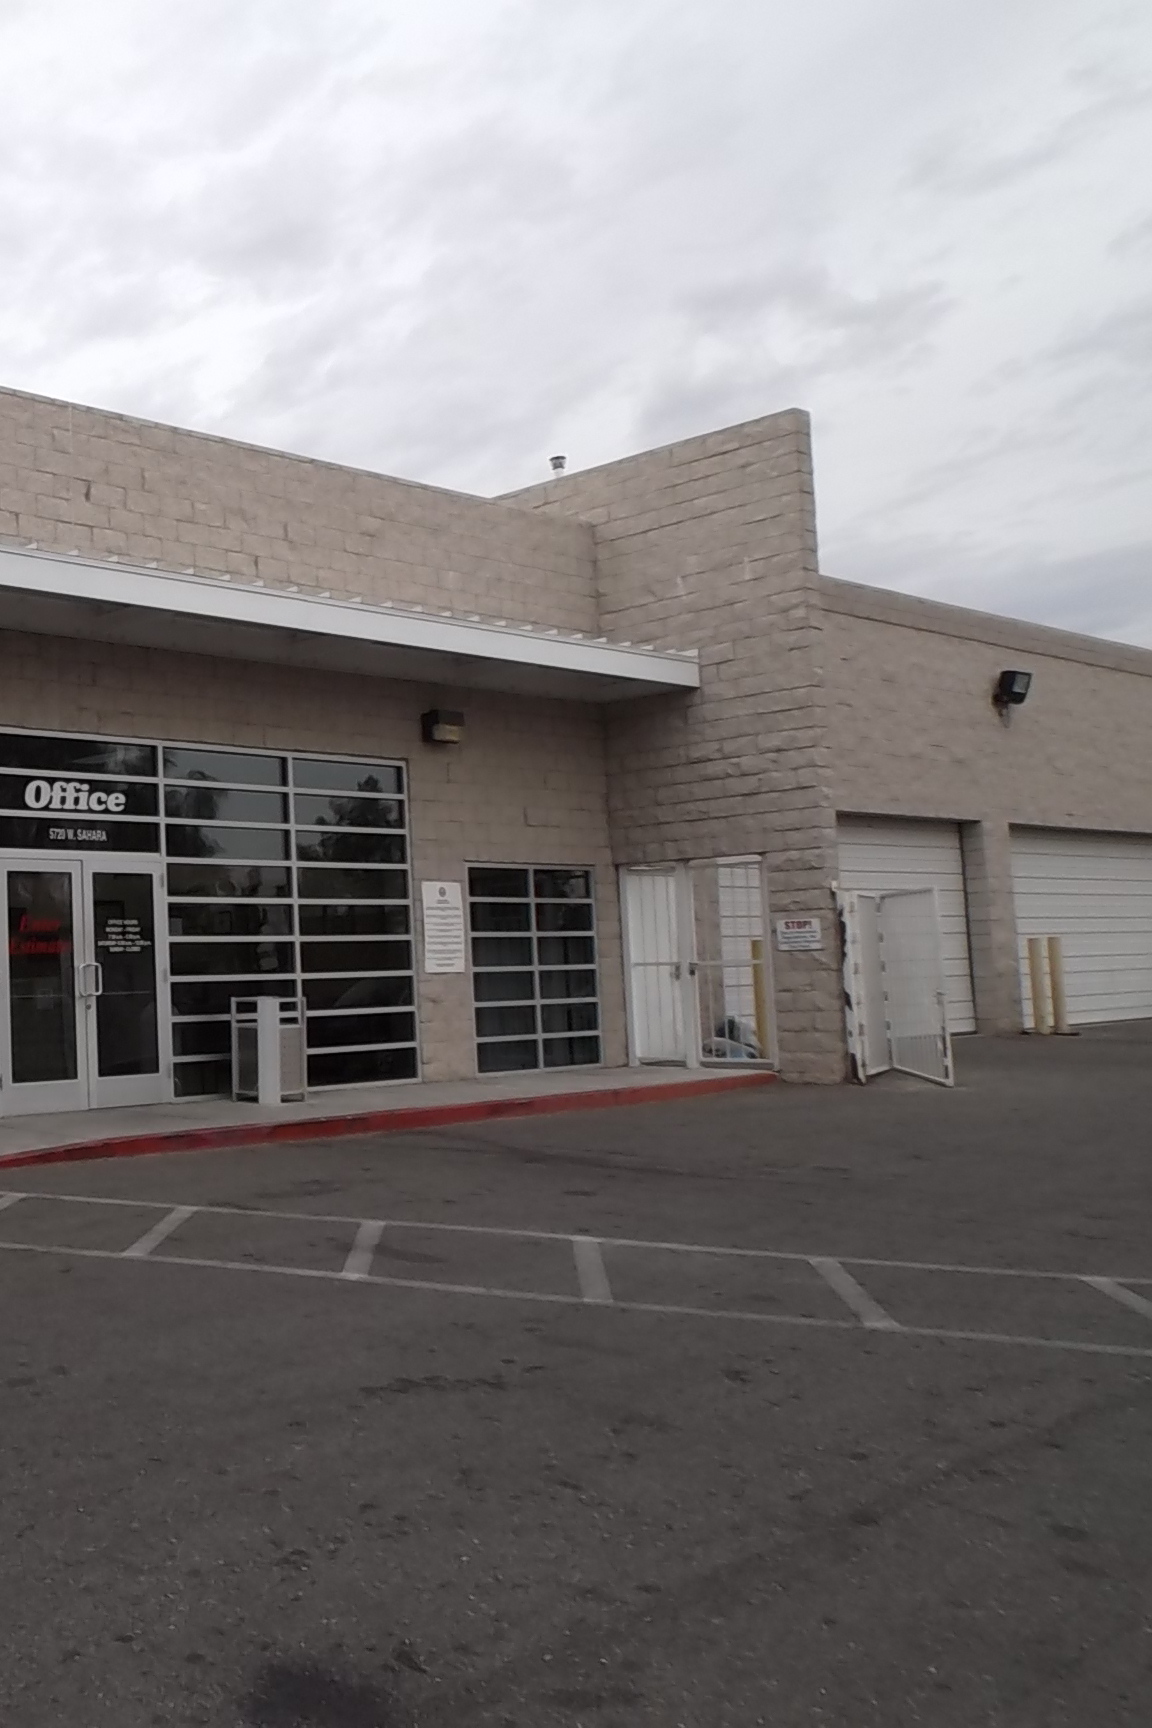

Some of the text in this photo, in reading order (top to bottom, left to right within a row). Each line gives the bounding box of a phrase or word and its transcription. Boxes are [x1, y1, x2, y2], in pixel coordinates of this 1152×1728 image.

[24, 780, 126, 812] Office
[49, 828, 107, 841] 5720 W. SAHARA
[784, 920, 812, 930] STOP!
